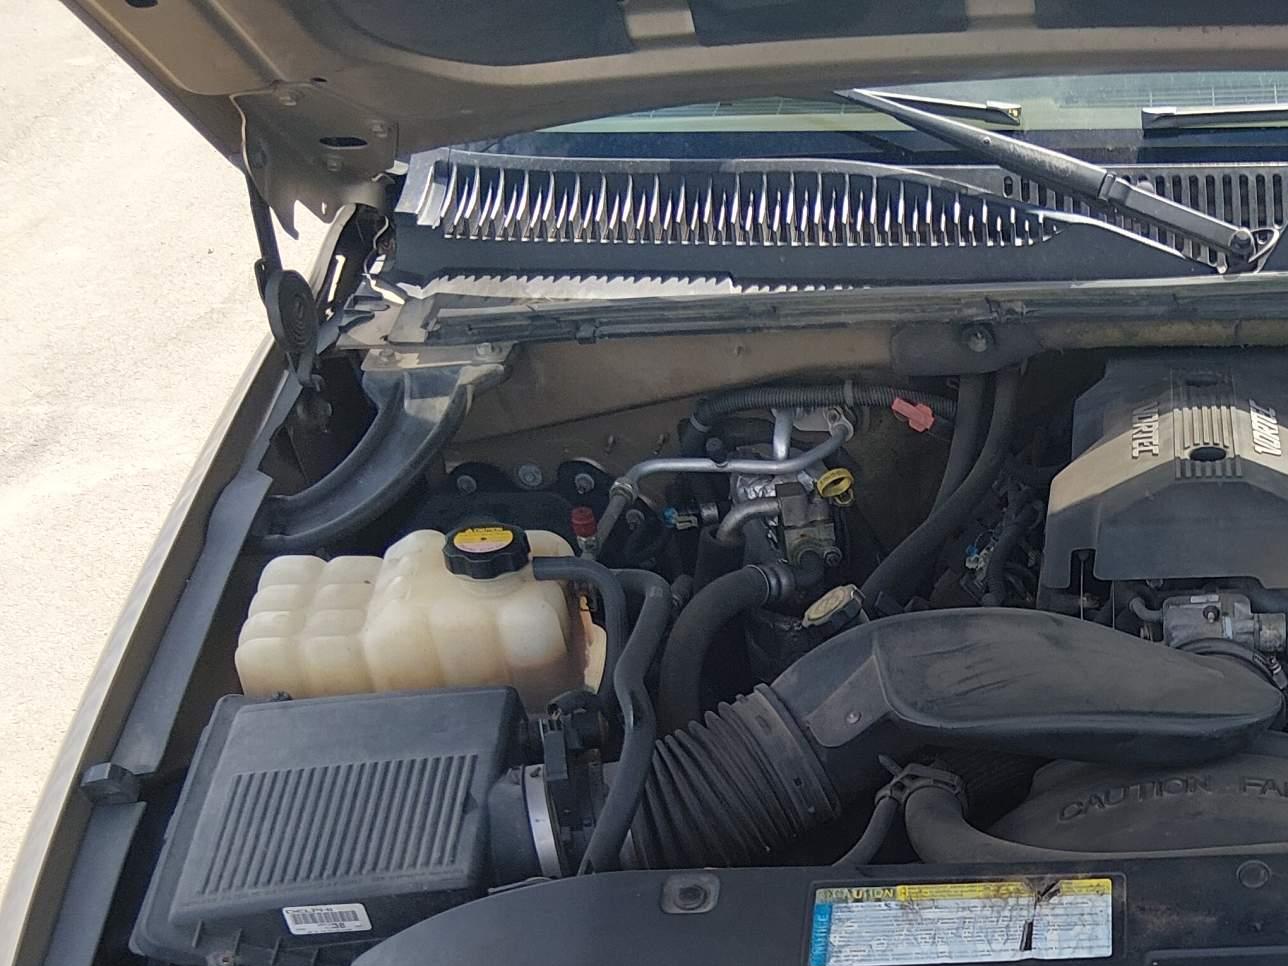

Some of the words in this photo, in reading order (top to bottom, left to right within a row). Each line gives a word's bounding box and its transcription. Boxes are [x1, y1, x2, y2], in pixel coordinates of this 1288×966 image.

[1132, 401, 1159, 459] VORTEC
[1249, 399, 1282, 457] VORTEC
[1057, 774, 1213, 822] CAUTION
